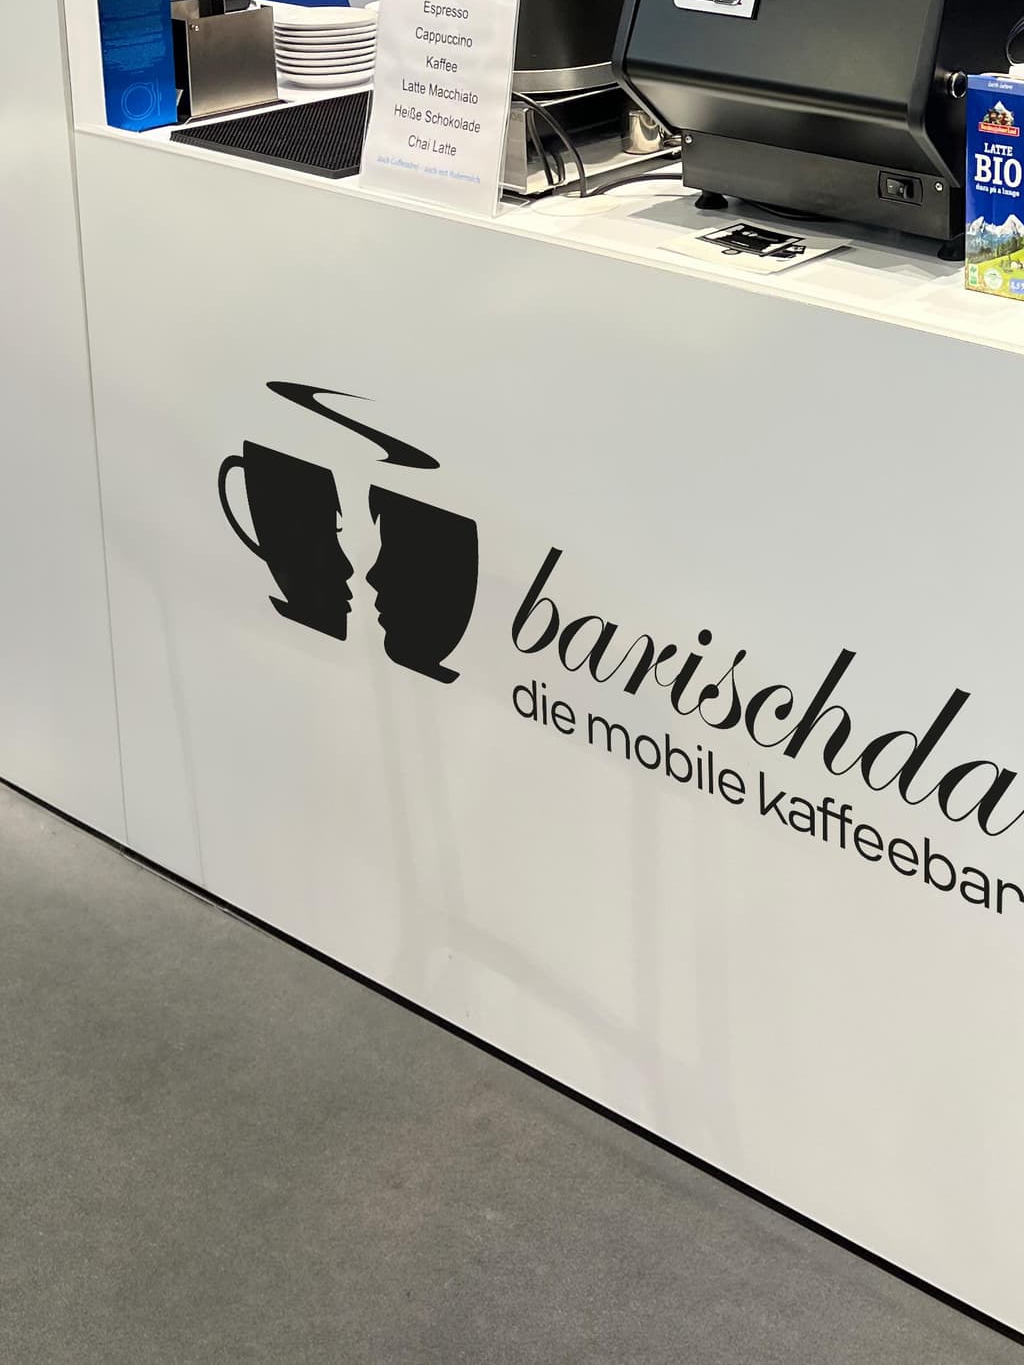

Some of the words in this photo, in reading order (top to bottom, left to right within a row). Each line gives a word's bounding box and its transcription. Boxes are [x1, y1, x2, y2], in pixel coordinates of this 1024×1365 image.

[424, 0, 469, 19] Espresso
[415, 26, 473, 48] Cappuccino
[426, 55, 458, 73] Kaffee
[402, 78, 426, 95] Latte
[428, 83, 479, 105] Macchiato
[394, 104, 422, 121] Heiße
[424, 110, 481, 133] Schokolade
[408, 134, 431, 150] Chai
[432, 140, 457, 156] Latte
[984, 143, 1013, 156] LATTE
[974, 153, 1022, 188] BIO
[512, 680, 576, 734] die
[587, 713, 745, 805] mobile
[759, 771, 1024, 914] kaffeebar
